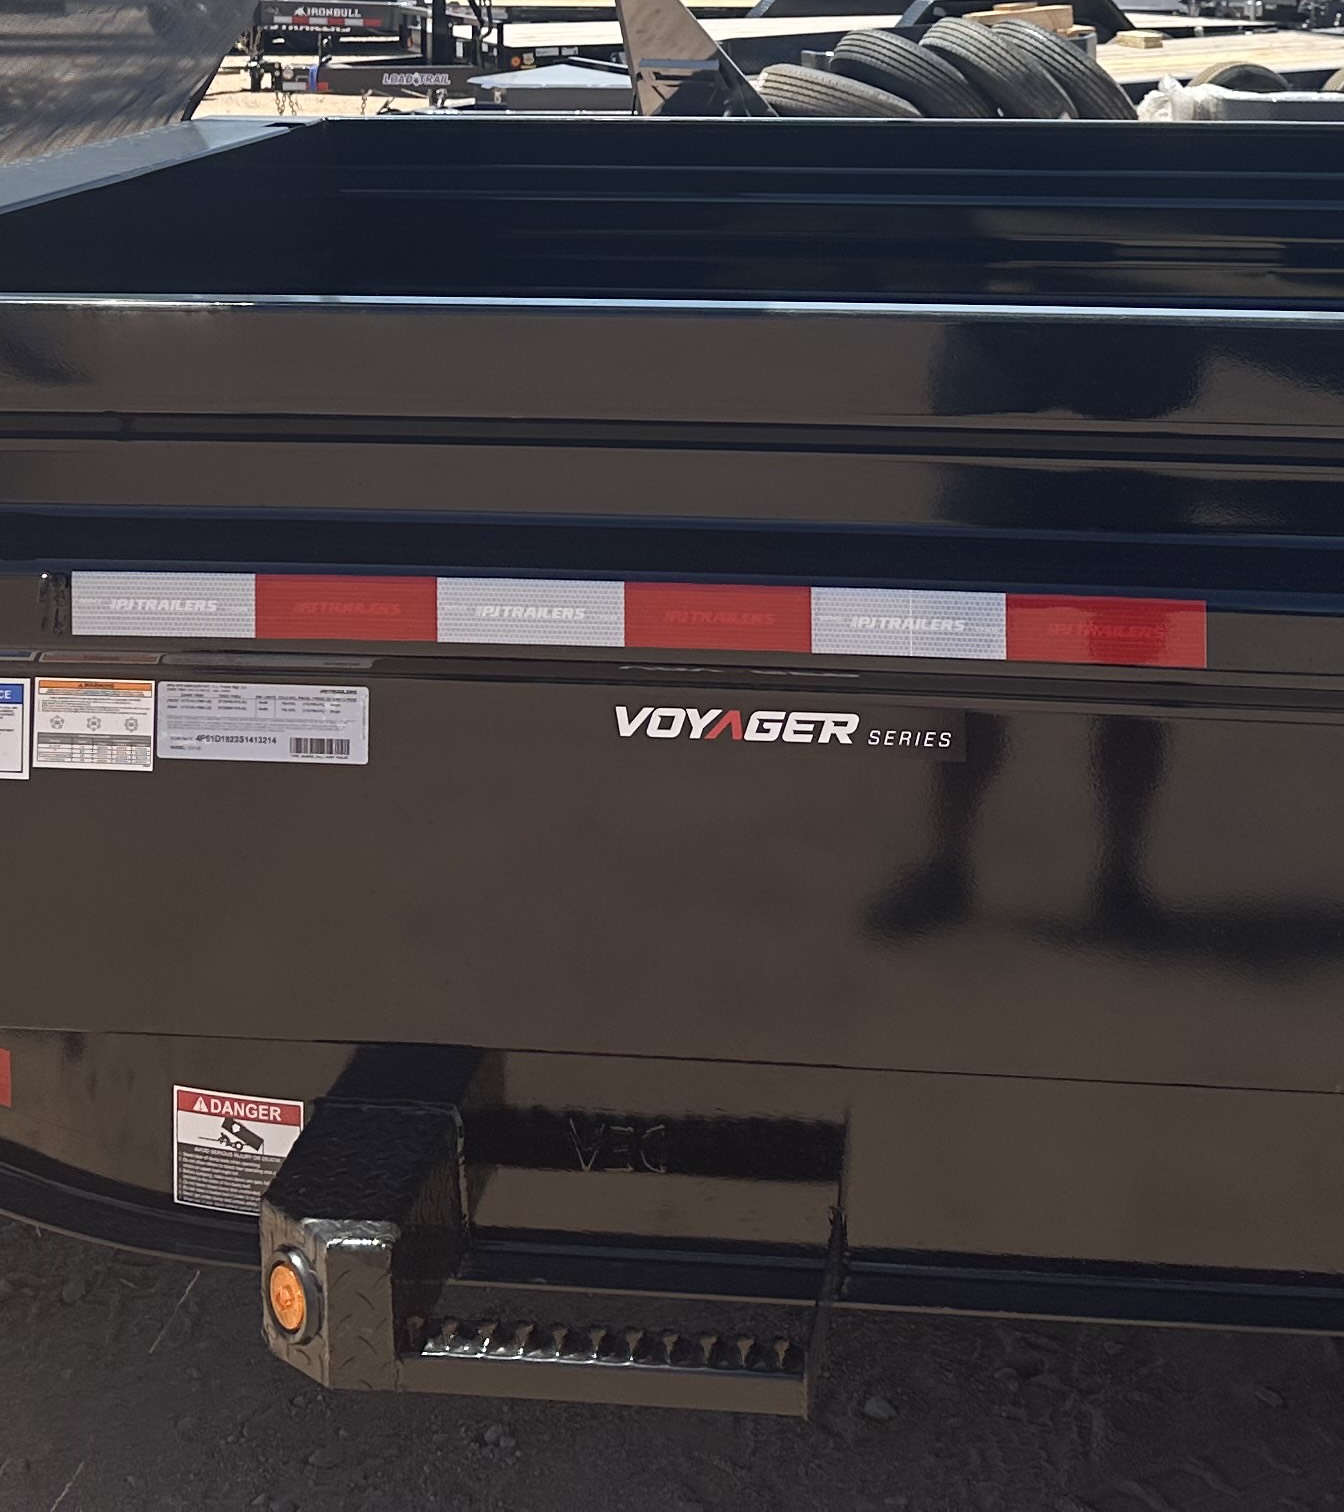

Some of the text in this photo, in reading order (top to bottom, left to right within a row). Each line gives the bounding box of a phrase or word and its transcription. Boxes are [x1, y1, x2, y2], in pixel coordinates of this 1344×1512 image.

[615, 705, 952, 748] VOYAGER SERIES
[210, 1098, 282, 1122] DANGER
